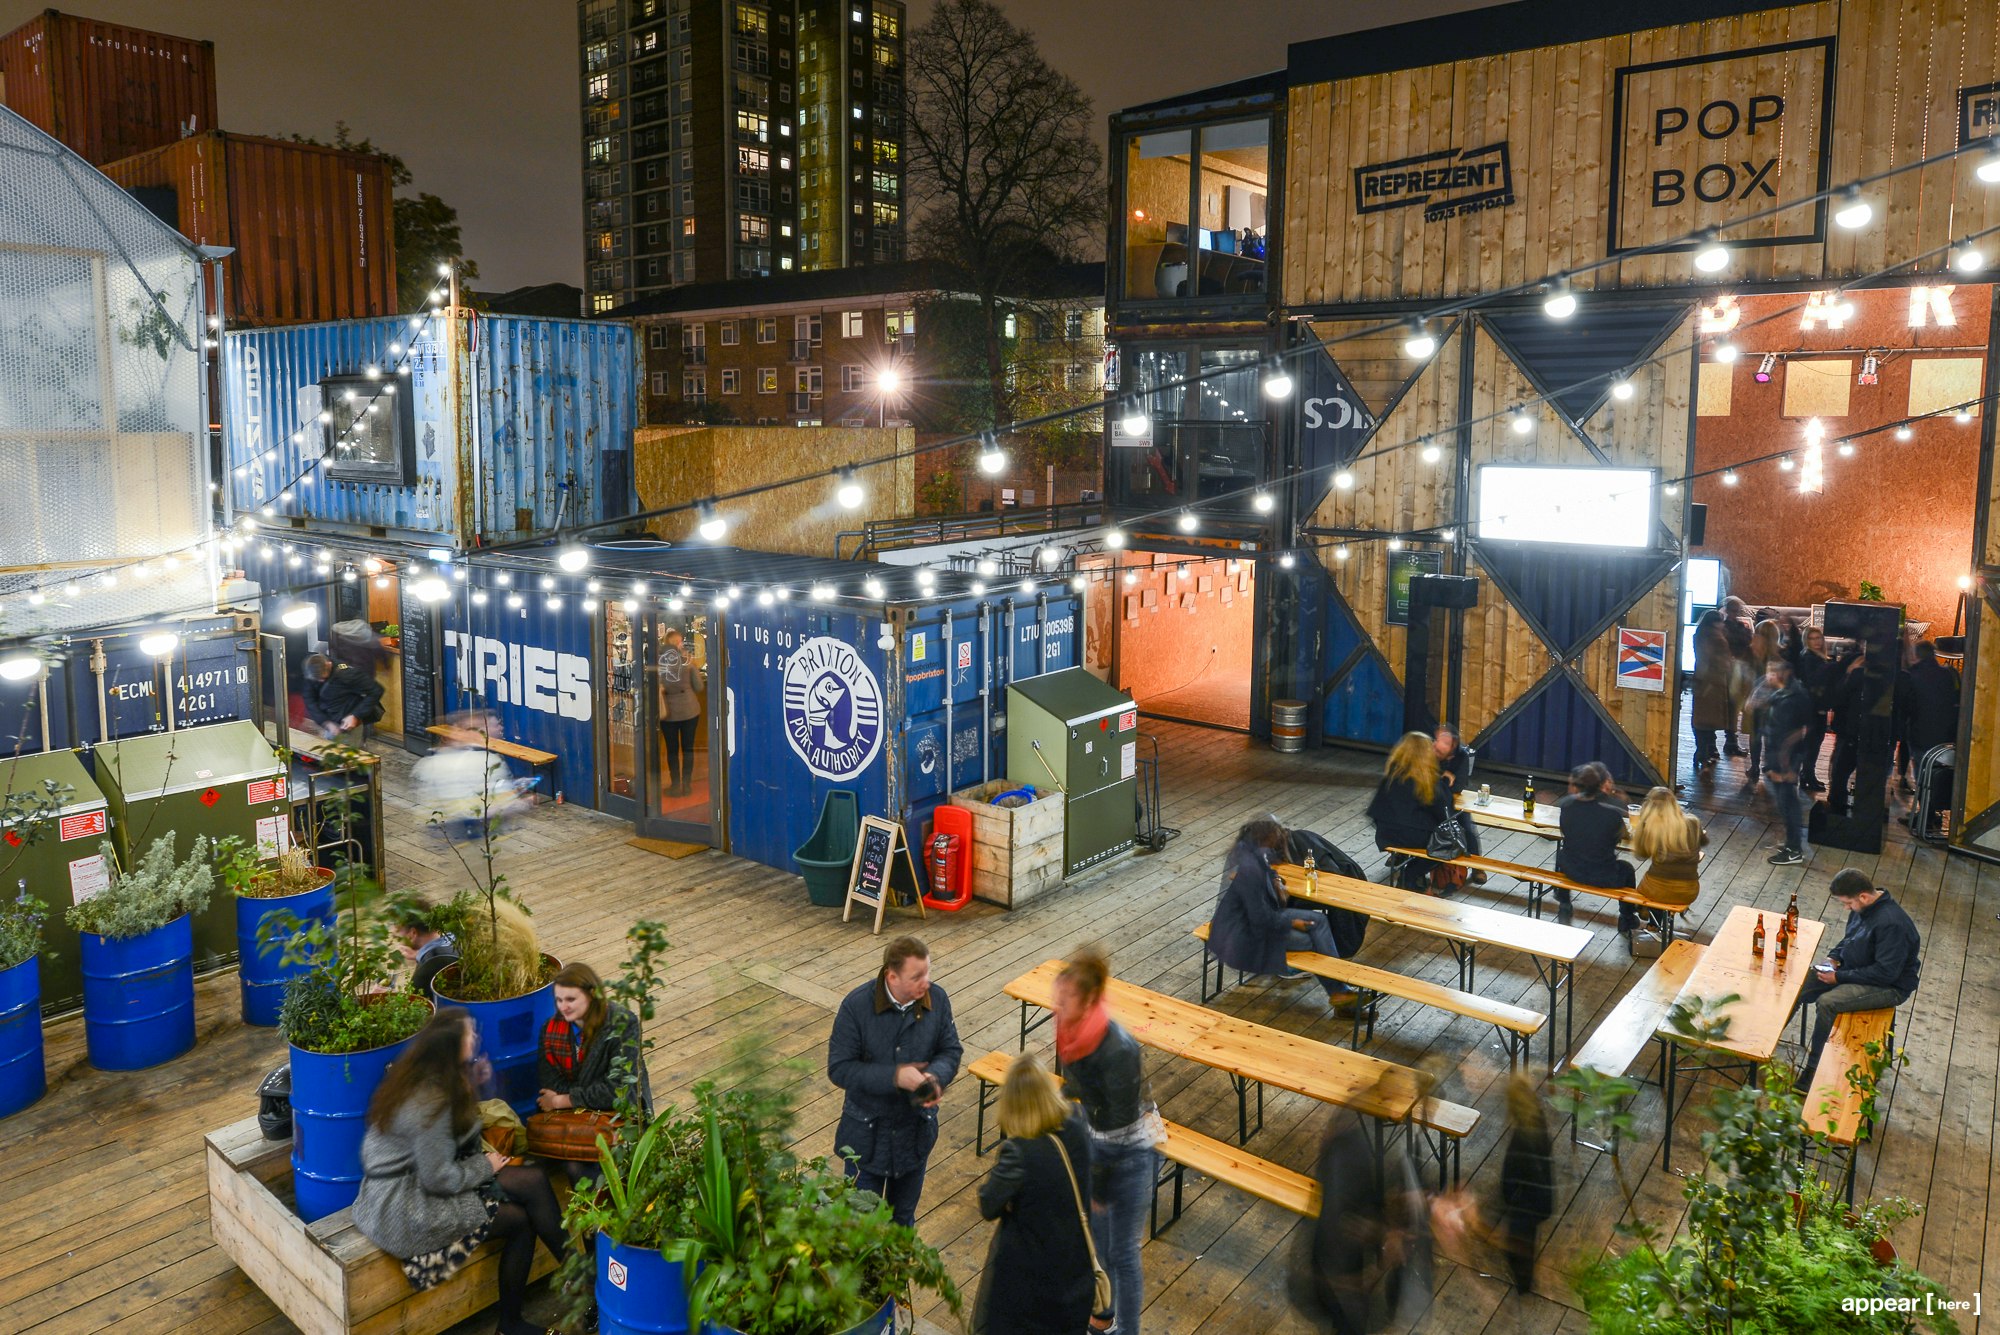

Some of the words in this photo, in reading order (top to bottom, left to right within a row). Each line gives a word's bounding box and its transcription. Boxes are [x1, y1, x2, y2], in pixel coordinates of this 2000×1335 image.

[1655, 95, 1785, 146] POP
[1973, 98, 2000, 127] R
[1365, 162, 1501, 198] REPREZENT
[1652, 158, 1778, 208] BOX
[1021, 623, 1039, 643] LTIU
[177, 669, 230, 691] 414971
[444, 630, 592, 721] TRIES
[798, 642, 862, 686] BRIXTON
[179, 692, 215, 713] 42G1
[789, 716, 814, 754] PORT
[811, 730, 870, 772] AUTHORITY
